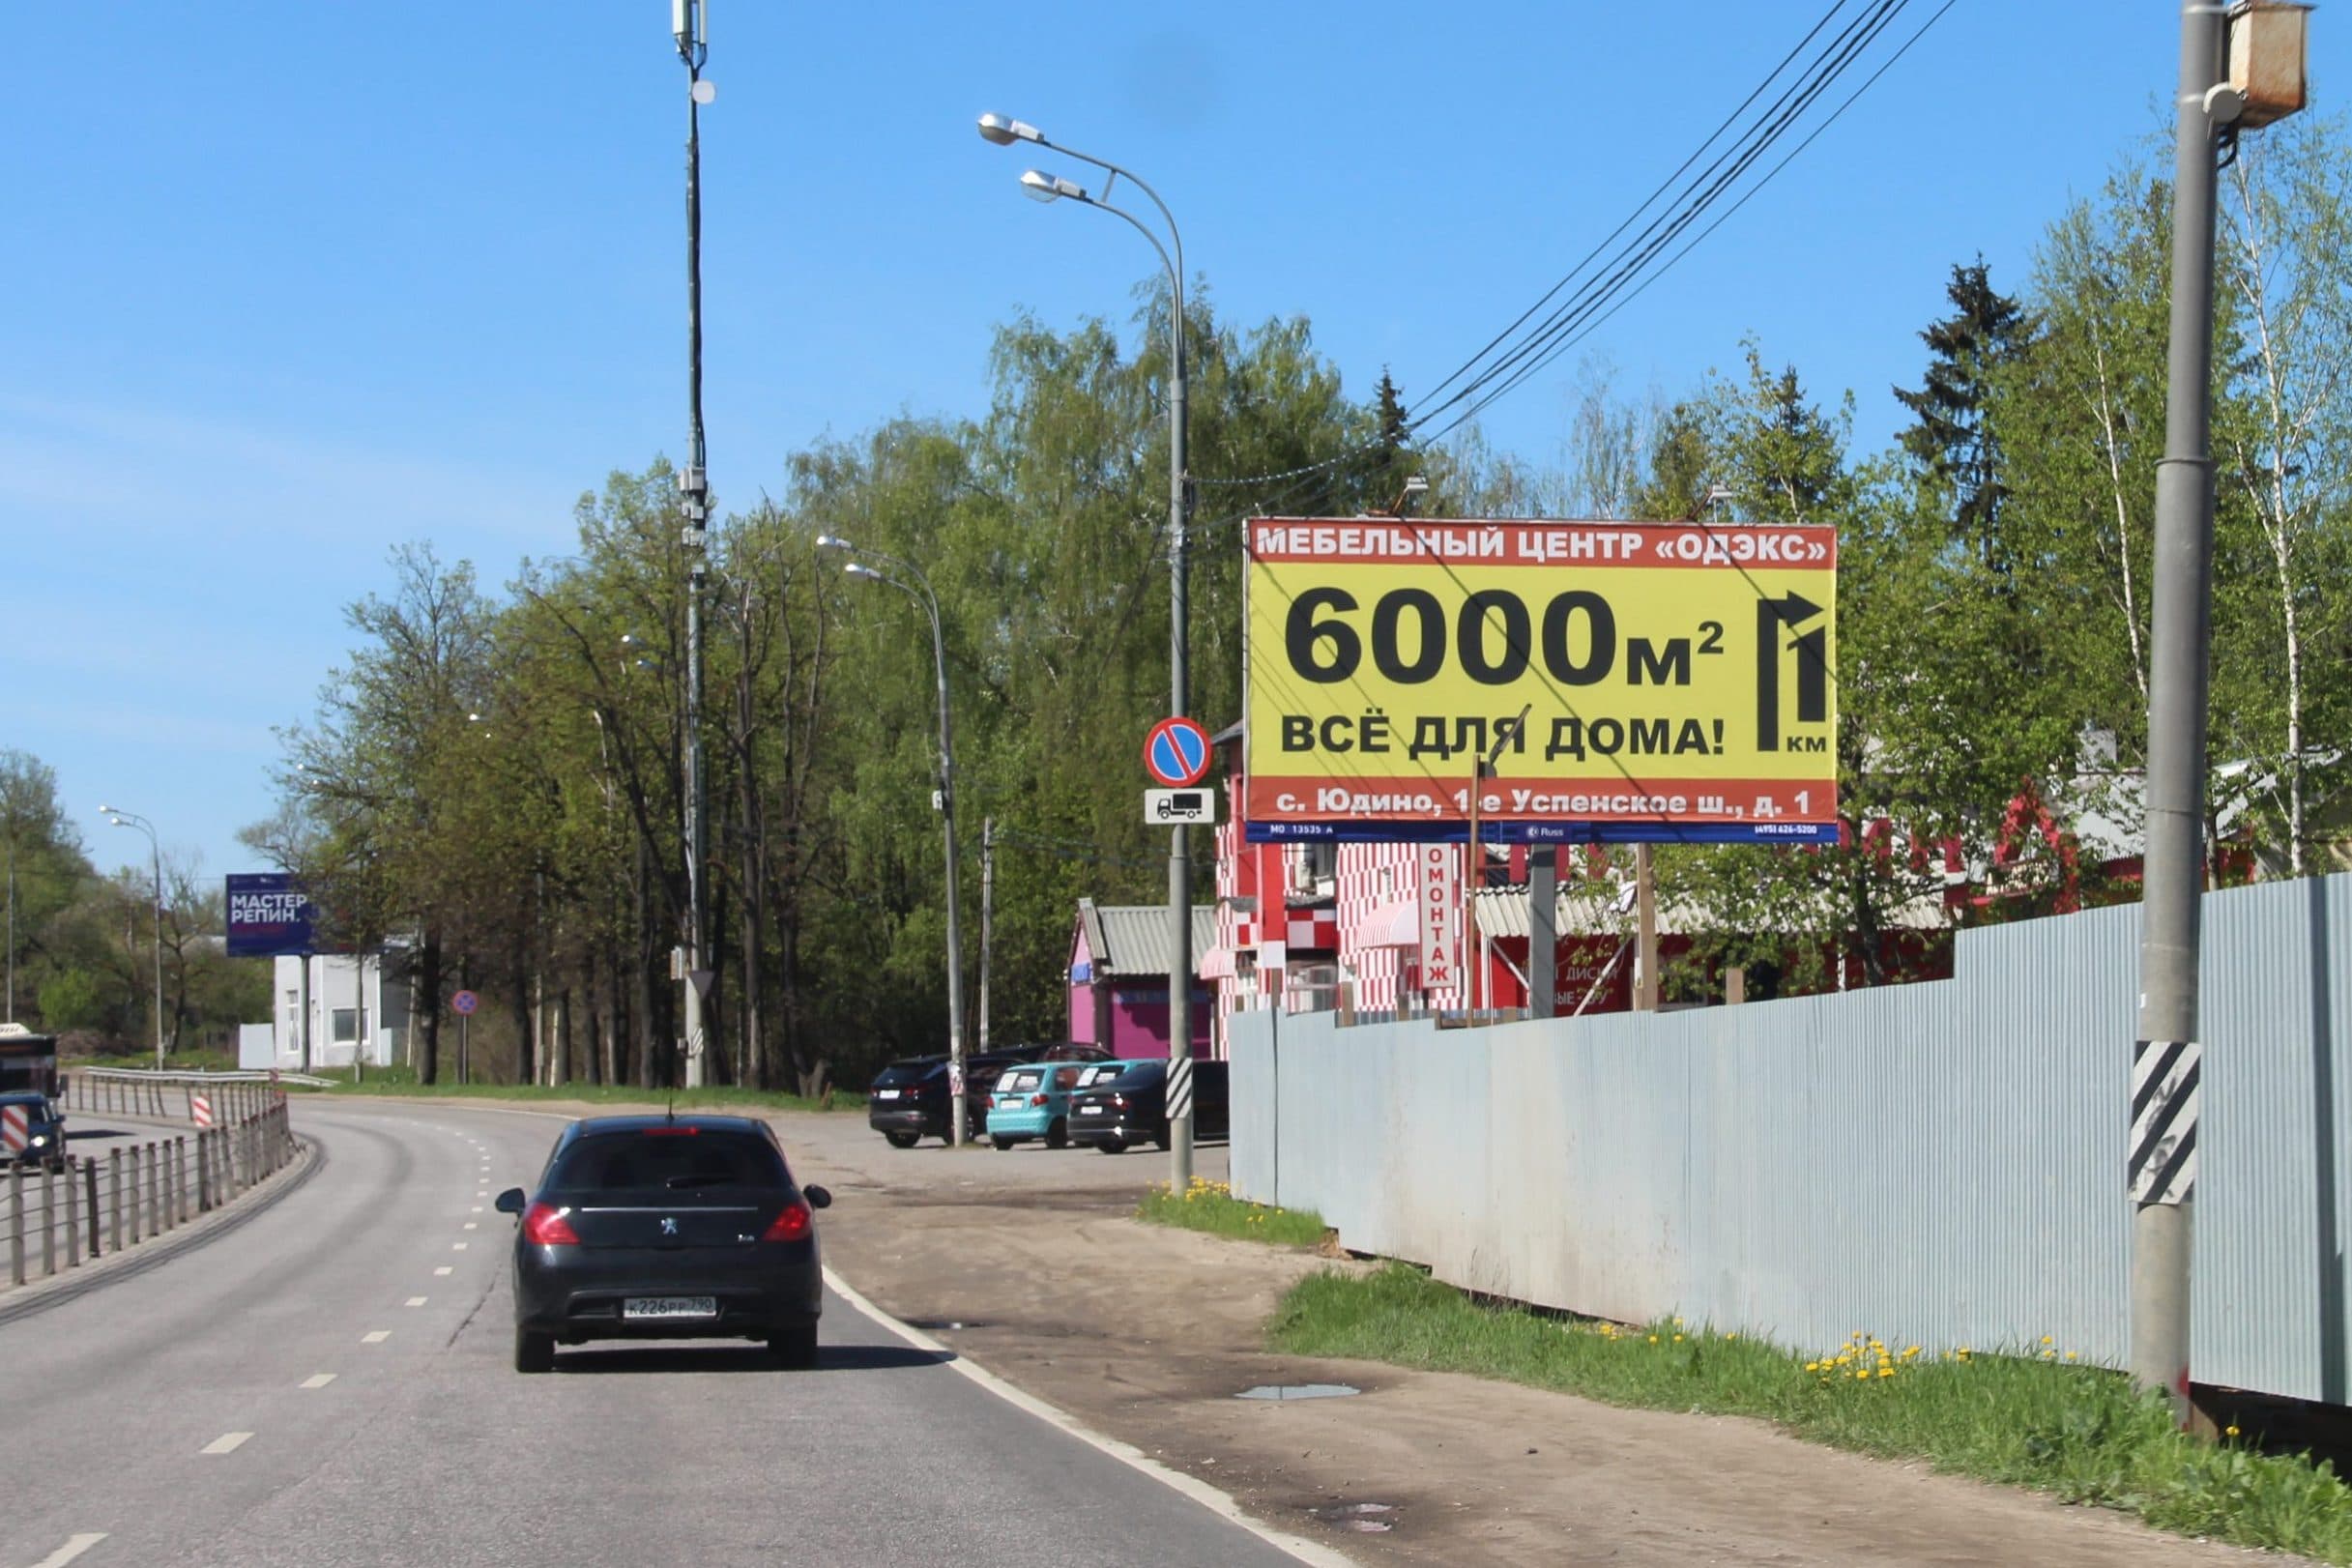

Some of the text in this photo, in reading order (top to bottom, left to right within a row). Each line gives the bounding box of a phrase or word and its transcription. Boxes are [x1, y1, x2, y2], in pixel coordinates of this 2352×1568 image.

[1257, 526, 1826, 565] МЕБЕЛЬНЫЙ ЦЕНТР «ОДЭКС»
[1282, 708, 1725, 762] ВСЁ ДЛЯ ДОМА!
[1276, 788, 1810, 820] с. Юдино, 1е Успенское ш., д. 1
[1540, 827, 1564, 836] Russ
[231, 894, 307, 909] МАСТЕР
